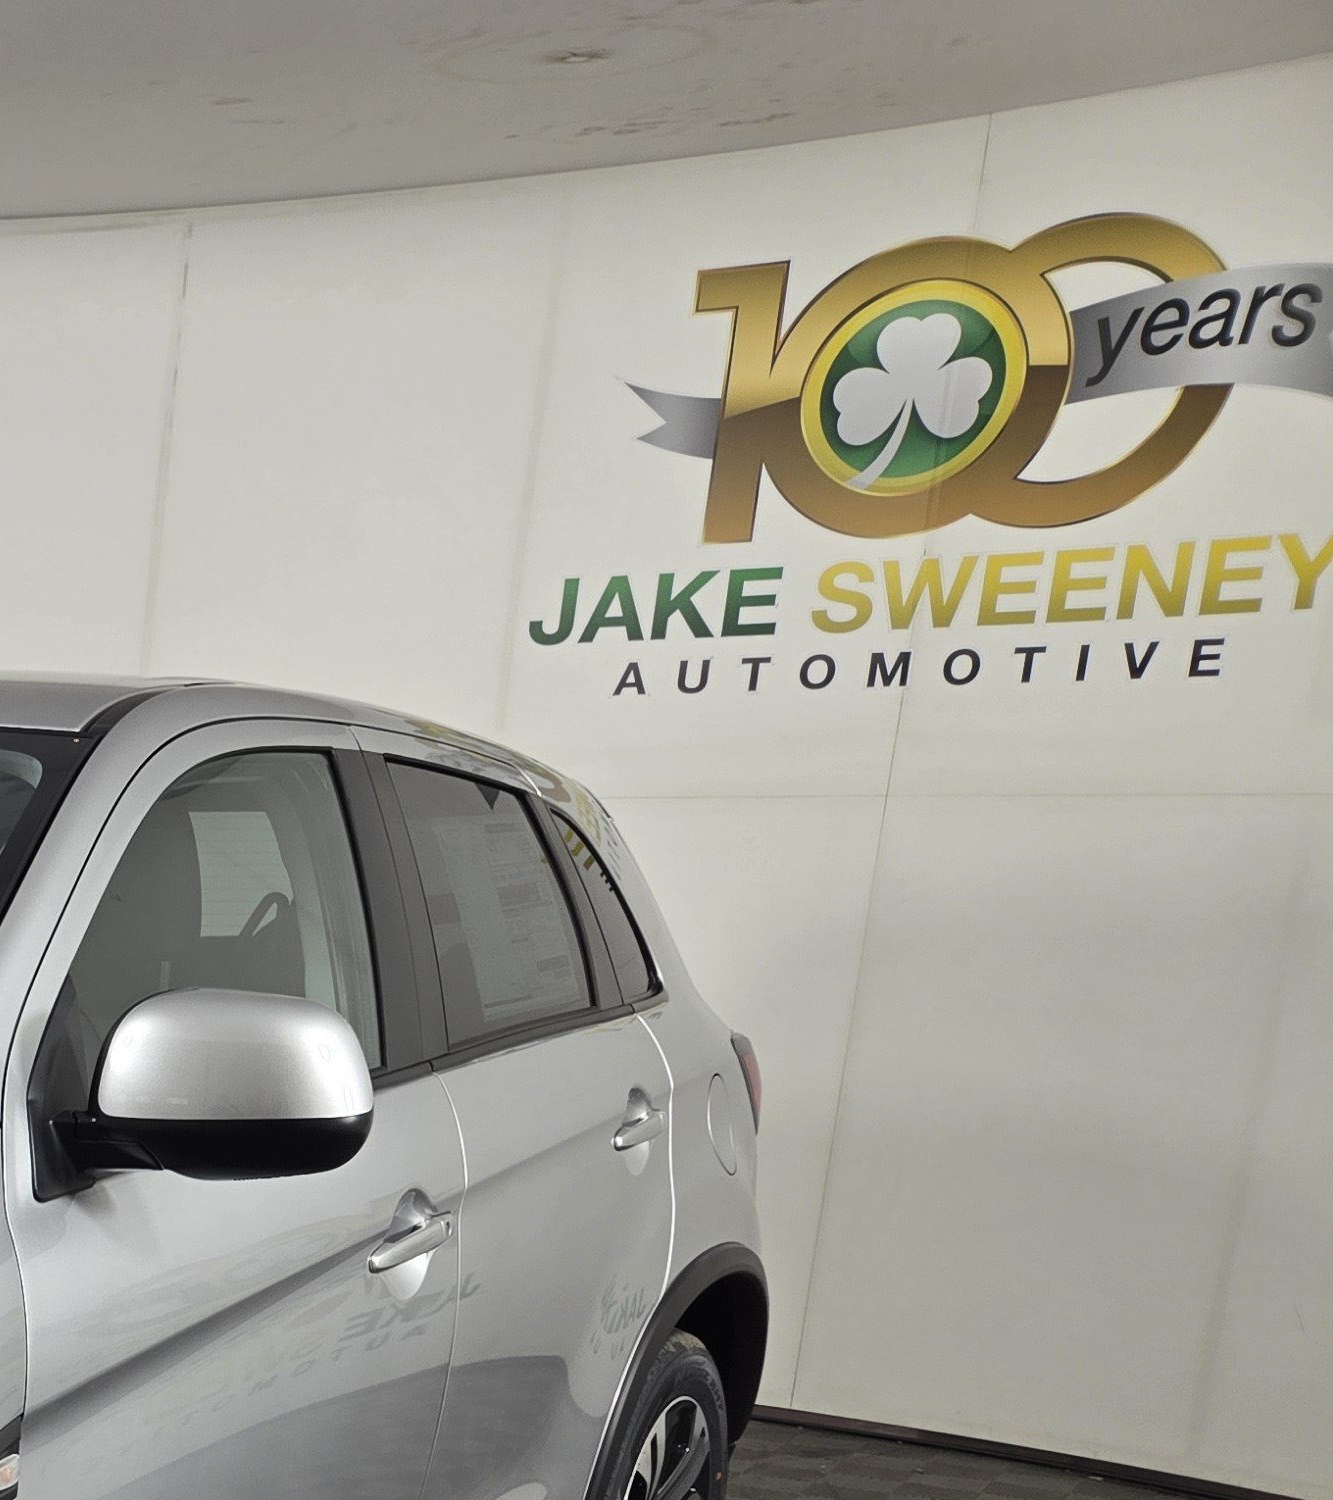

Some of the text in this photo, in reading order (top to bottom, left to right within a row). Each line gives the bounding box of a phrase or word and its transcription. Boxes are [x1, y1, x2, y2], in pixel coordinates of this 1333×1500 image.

[694, 212, 1322, 545] 100 years
[528, 532, 1333, 646] JAKE SWEENEY
[612, 637, 1227, 697] AUTOMOTIVE
